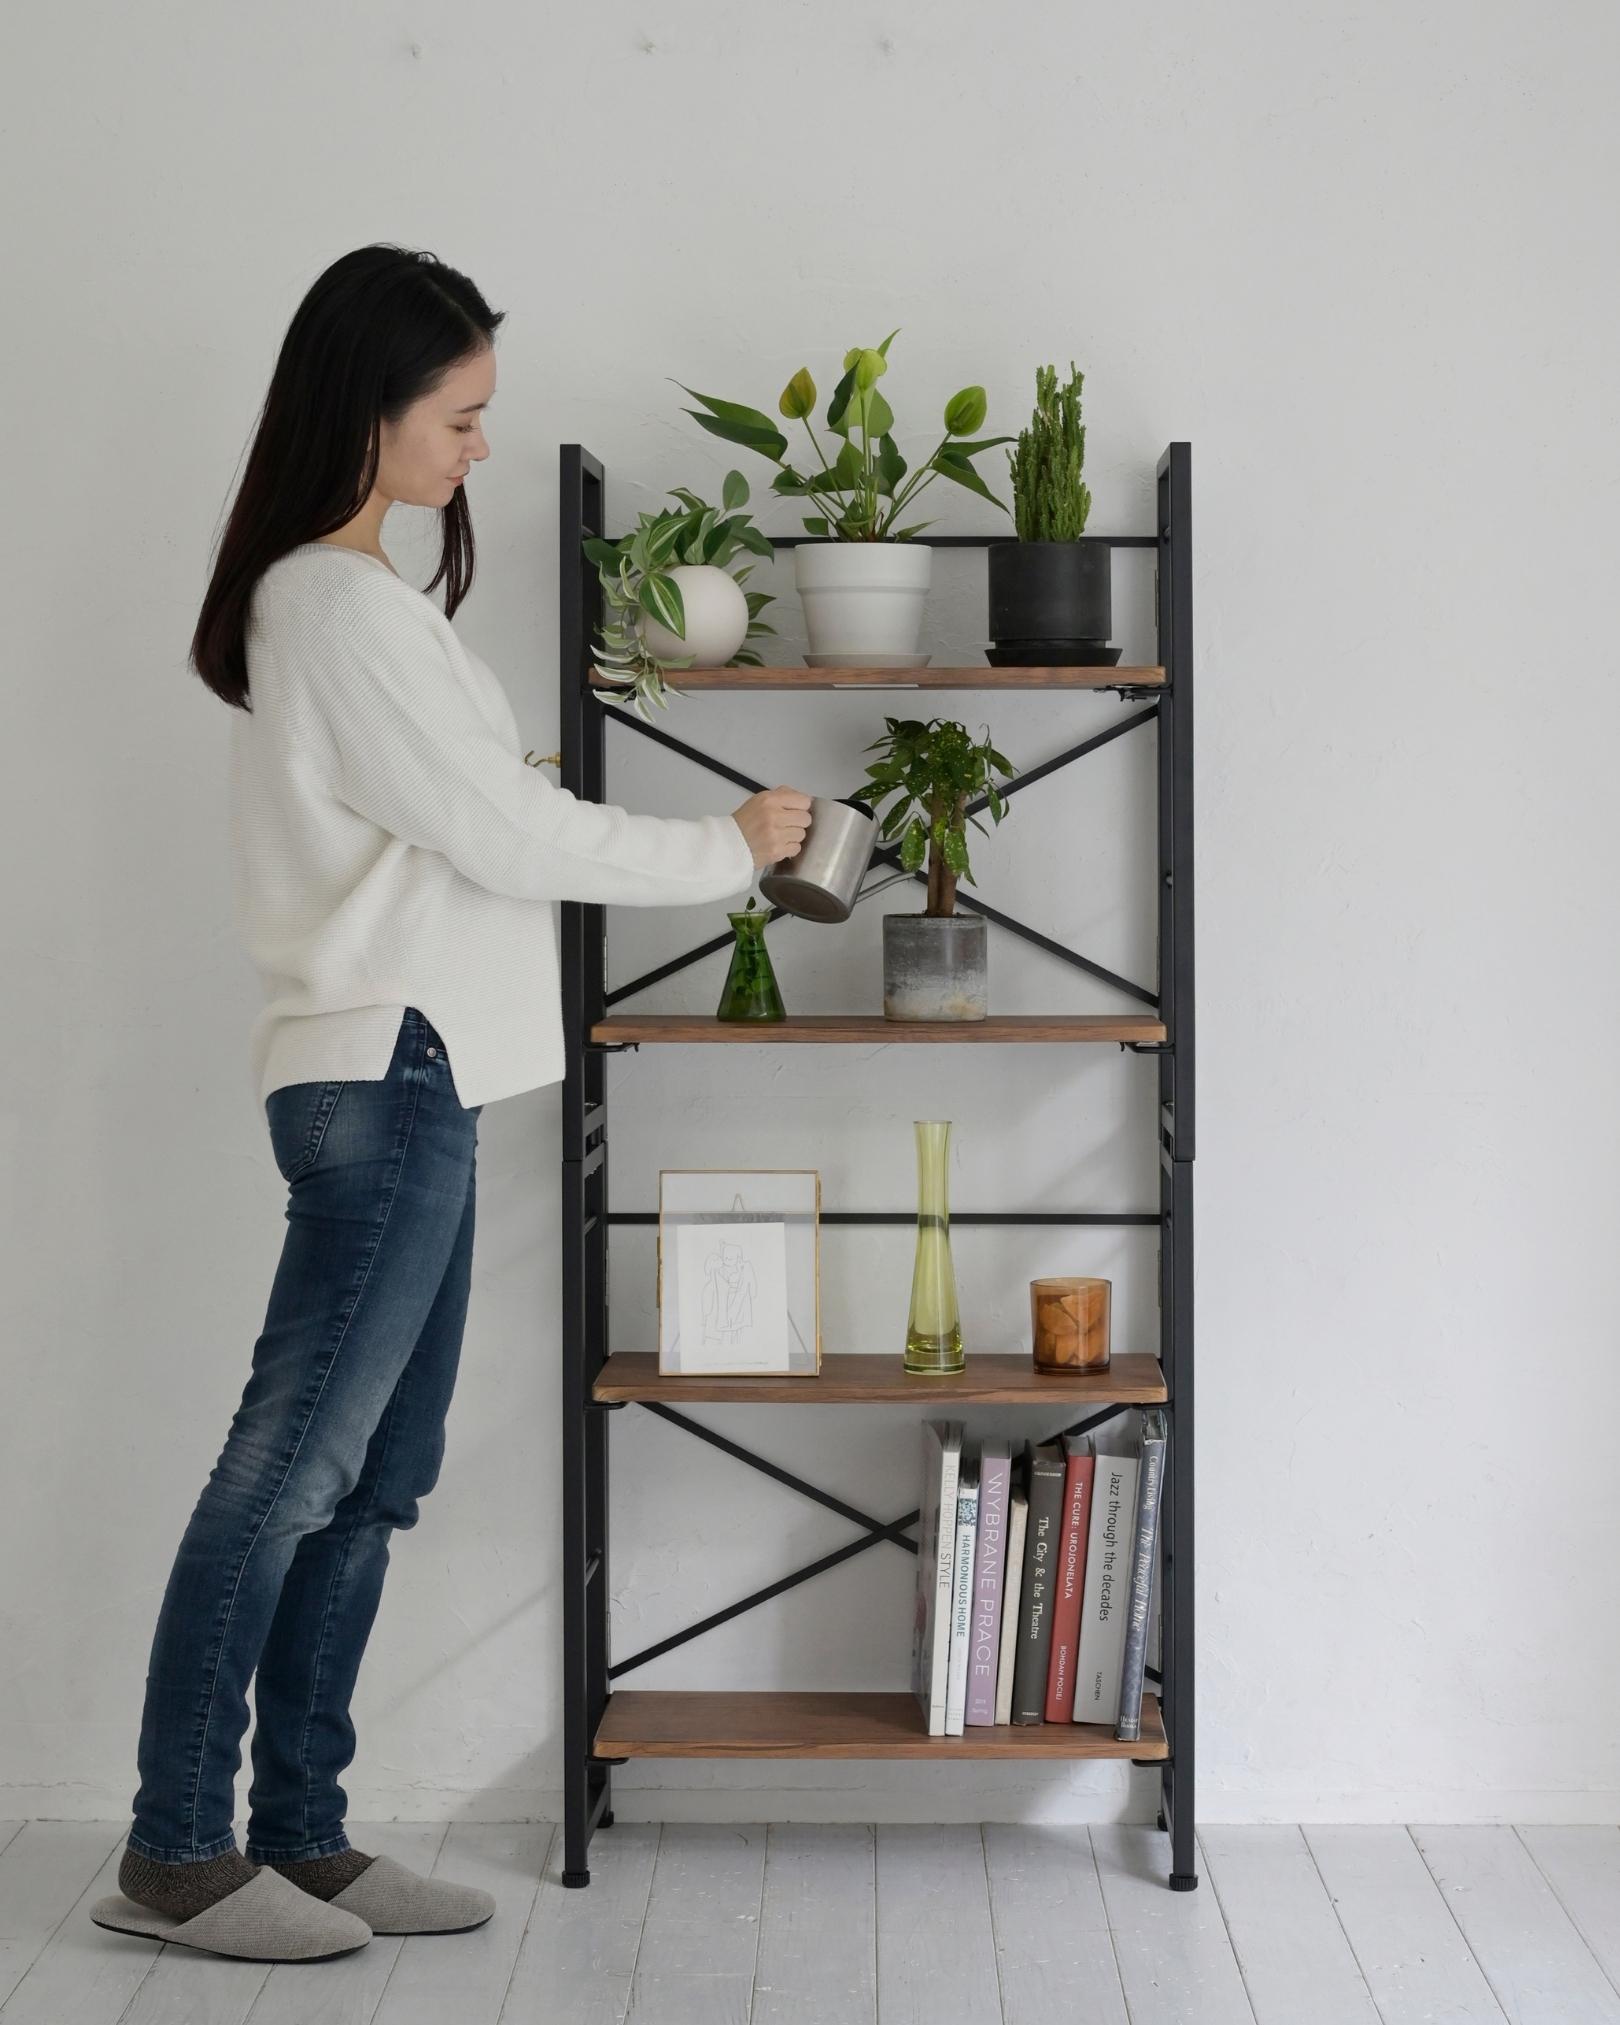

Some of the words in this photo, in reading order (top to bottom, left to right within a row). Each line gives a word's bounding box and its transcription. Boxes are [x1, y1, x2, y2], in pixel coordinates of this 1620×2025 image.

[1110, 1472, 1123, 1497] Jazz
[1146, 1456, 1158, 1487] Country
[1074, 1482, 1083, 1499] THE
[1143, 1488, 1156, 1511] Living
[940, 1503, 954, 1549] HOPPEN
[981, 1473, 1002, 1589] WYBRANE
[1038, 1517, 1049, 1537] The
[1071, 1503, 1081, 1529] CURE:
[1103, 1501, 1121, 1548] through
[1033, 1543, 1048, 1562] City
[1064, 1532, 1079, 1599] UROJONELATA
[1104, 1552, 1117, 1571] the
[938, 1553, 952, 1588] STYLE
[959, 1534, 971, 1605] HARMONIOUS
[1035, 1568, 1045, 1577] &
[1034, 1583, 1045, 1598] the
[1100, 1574, 1115, 1621] decades
[957, 1608, 967, 1637] HOME
[1031, 1603, 1043, 1639] Theatre
[975, 1600, 994, 1676] PRACE
[1058, 1645, 1067, 1676] BOHDAN
[1094, 1672, 1103, 1700] TASCHEN
